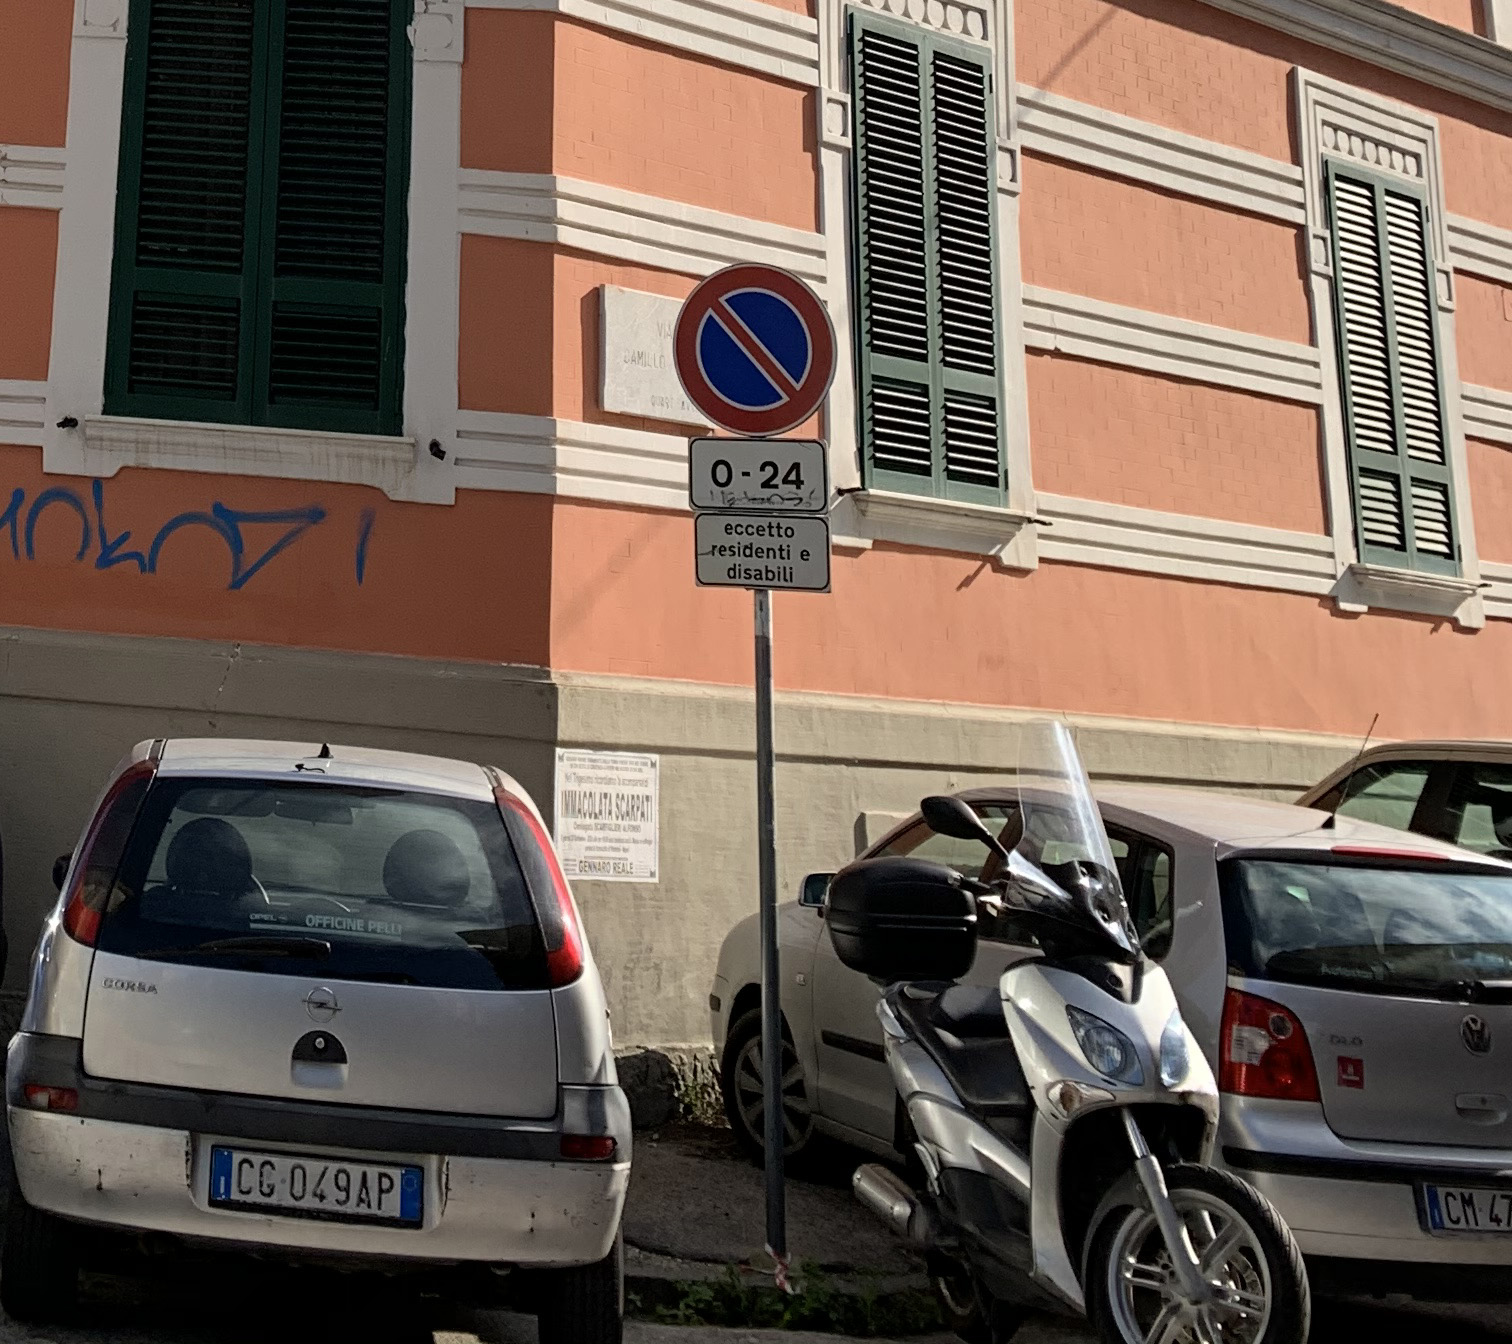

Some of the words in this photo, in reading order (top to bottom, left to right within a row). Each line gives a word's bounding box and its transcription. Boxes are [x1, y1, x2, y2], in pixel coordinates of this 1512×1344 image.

[759, 461, 805, 490] 24
[724, 521, 795, 539] eccetto
[711, 542, 791, 561] residenti
[800, 549, 810, 561] e
[727, 563, 793, 583] disabili
[561, 790, 613, 821] IMMACOLATA
[615, 793, 653, 823] SCARPATI
[578, 860, 611, 873] GENNARO
[612, 862, 634, 875] REALE
[305, 914, 365, 932] OFFICINE
[238, 1158, 276, 1197] CG
[289, 1164, 395, 1211] 049AP
[1445, 1192, 1479, 1226] CM
